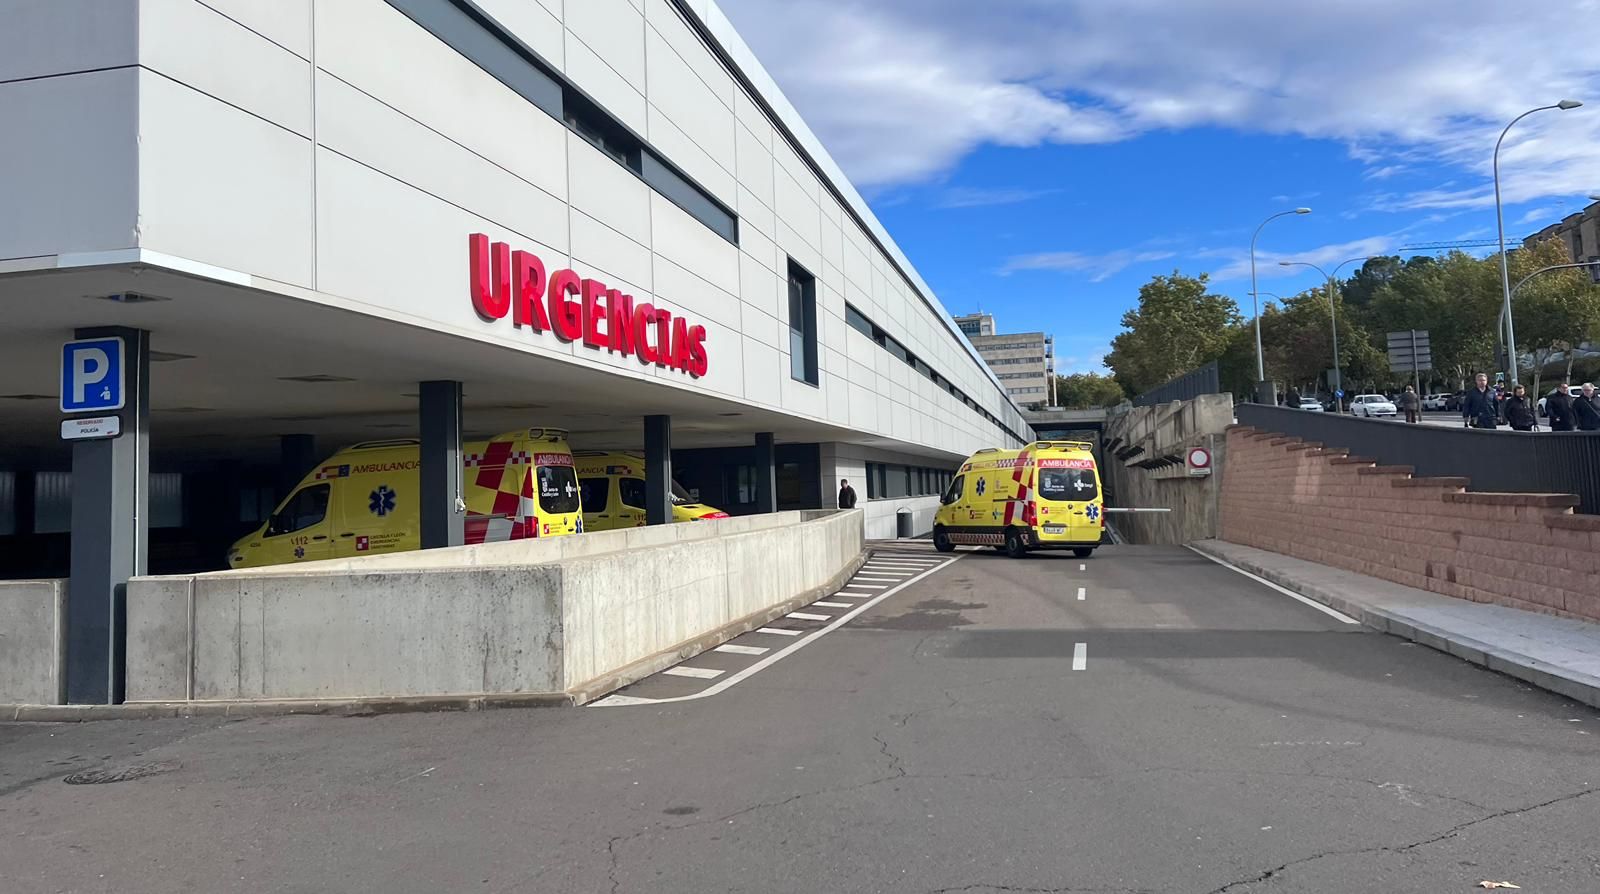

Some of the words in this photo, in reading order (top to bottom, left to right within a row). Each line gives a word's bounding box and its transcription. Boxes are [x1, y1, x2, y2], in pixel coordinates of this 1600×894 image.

[469, 233, 708, 378] URGENCIAS
[73, 348, 108, 403] P
[1041, 459, 1092, 467] AMBULANCIA
